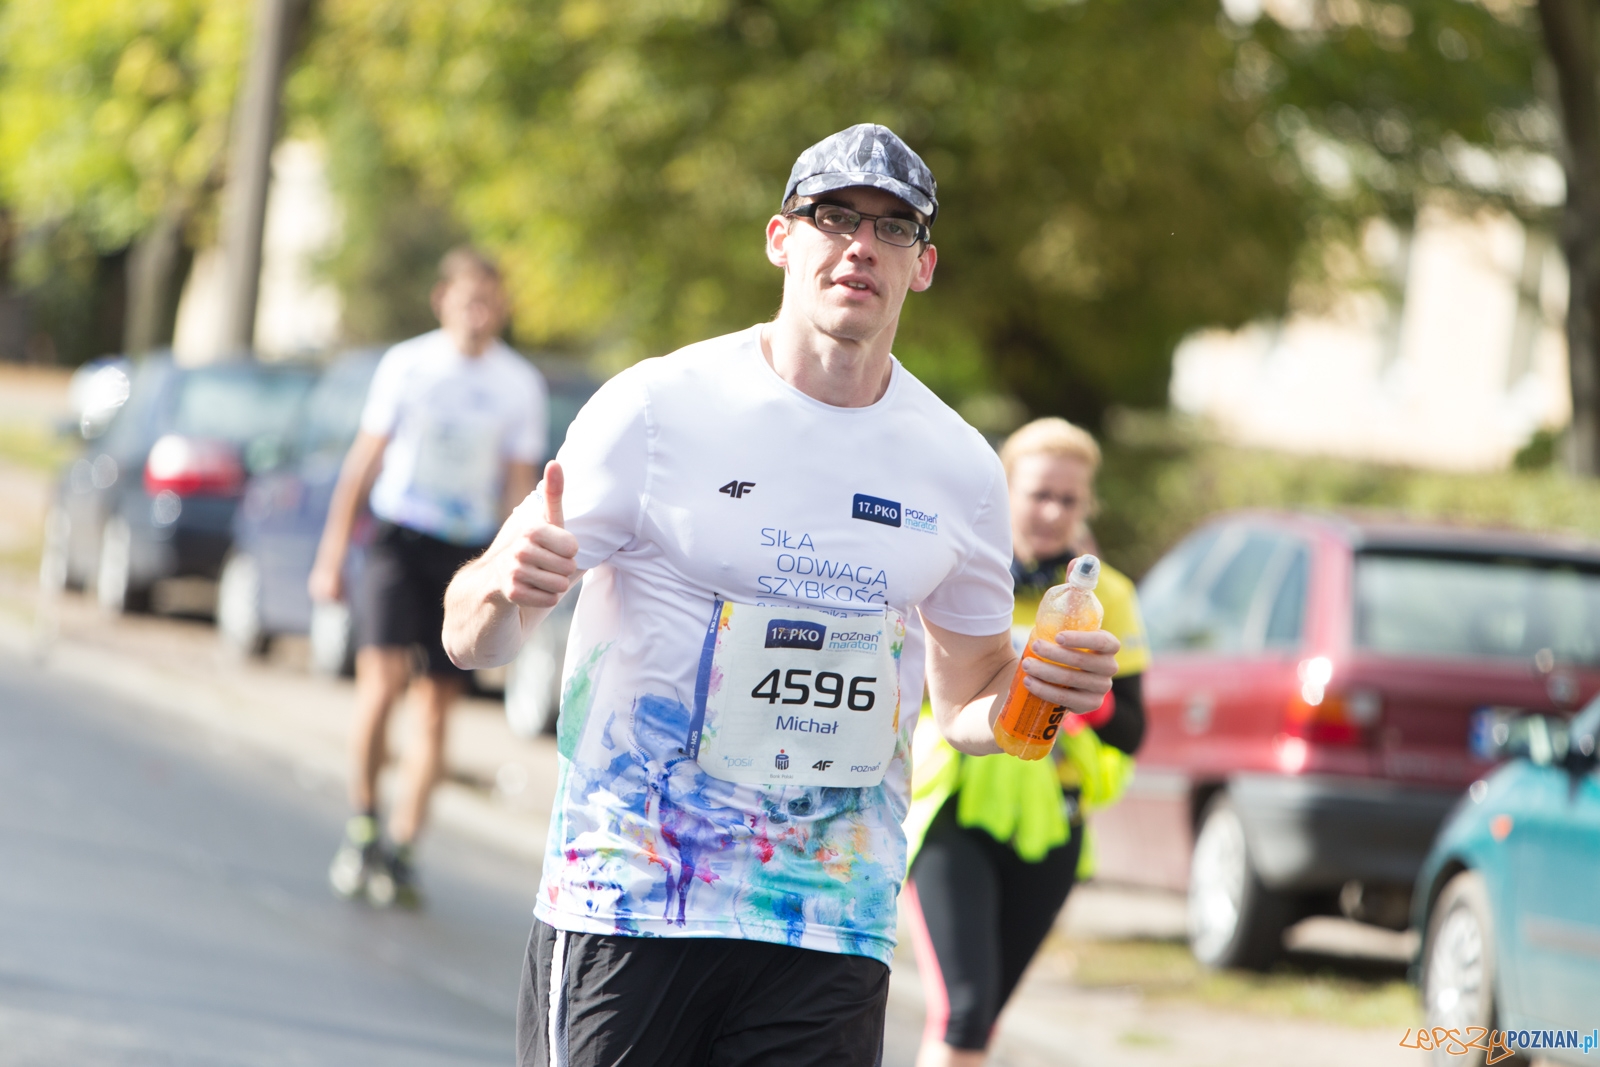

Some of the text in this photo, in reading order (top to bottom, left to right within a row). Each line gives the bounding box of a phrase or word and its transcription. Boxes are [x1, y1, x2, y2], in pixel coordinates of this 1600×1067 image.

[719, 480, 756, 498] 4F
[761, 528, 815, 551] SIŁA
[777, 554, 888, 590] ODWAGA
[828, 639, 877, 652] maraton
[751, 668, 877, 712] 4596
[775, 715, 839, 735] Michał
[811, 760, 833, 772] 4F
